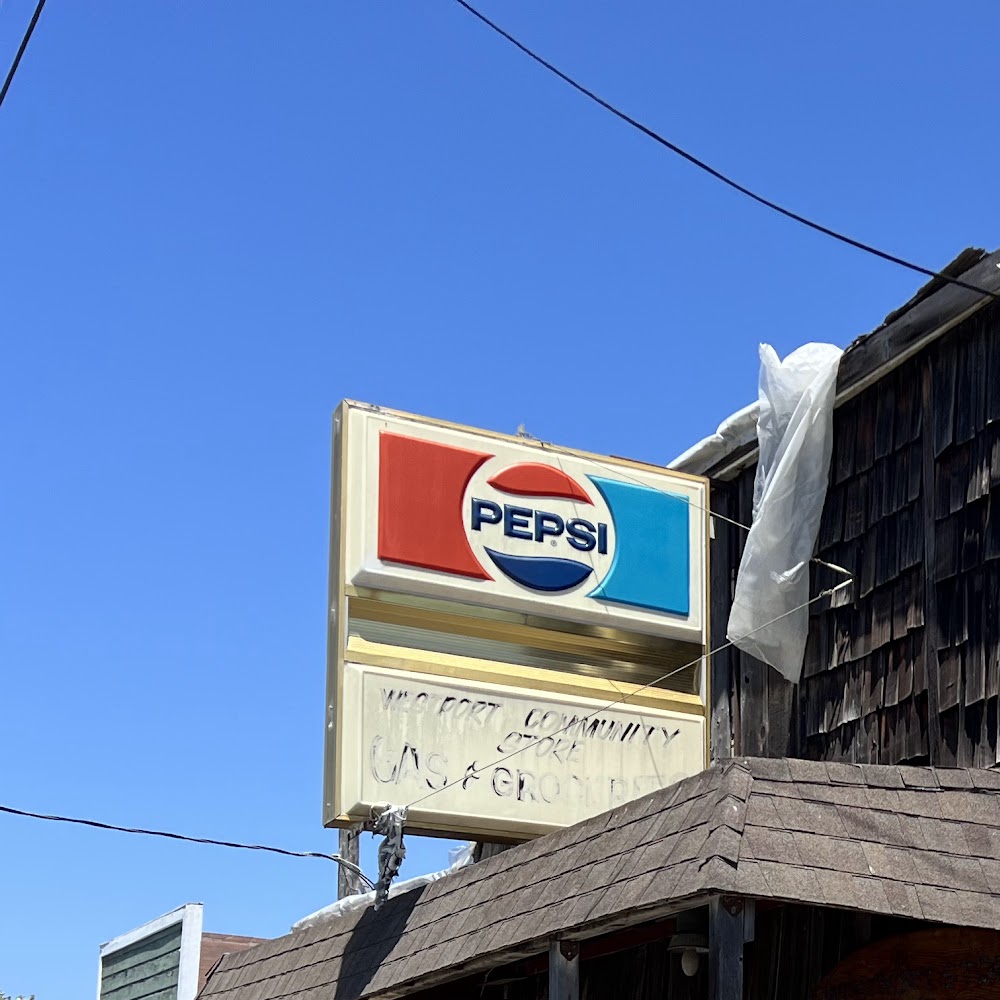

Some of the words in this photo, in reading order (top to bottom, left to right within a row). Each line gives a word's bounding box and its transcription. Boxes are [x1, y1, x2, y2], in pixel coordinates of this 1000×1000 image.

[471, 497, 608, 555] PEPSI
[497, 732, 585, 764] STORE
[524, 707, 681, 748] COMMUNITY
[370, 735, 448, 790] GAS
